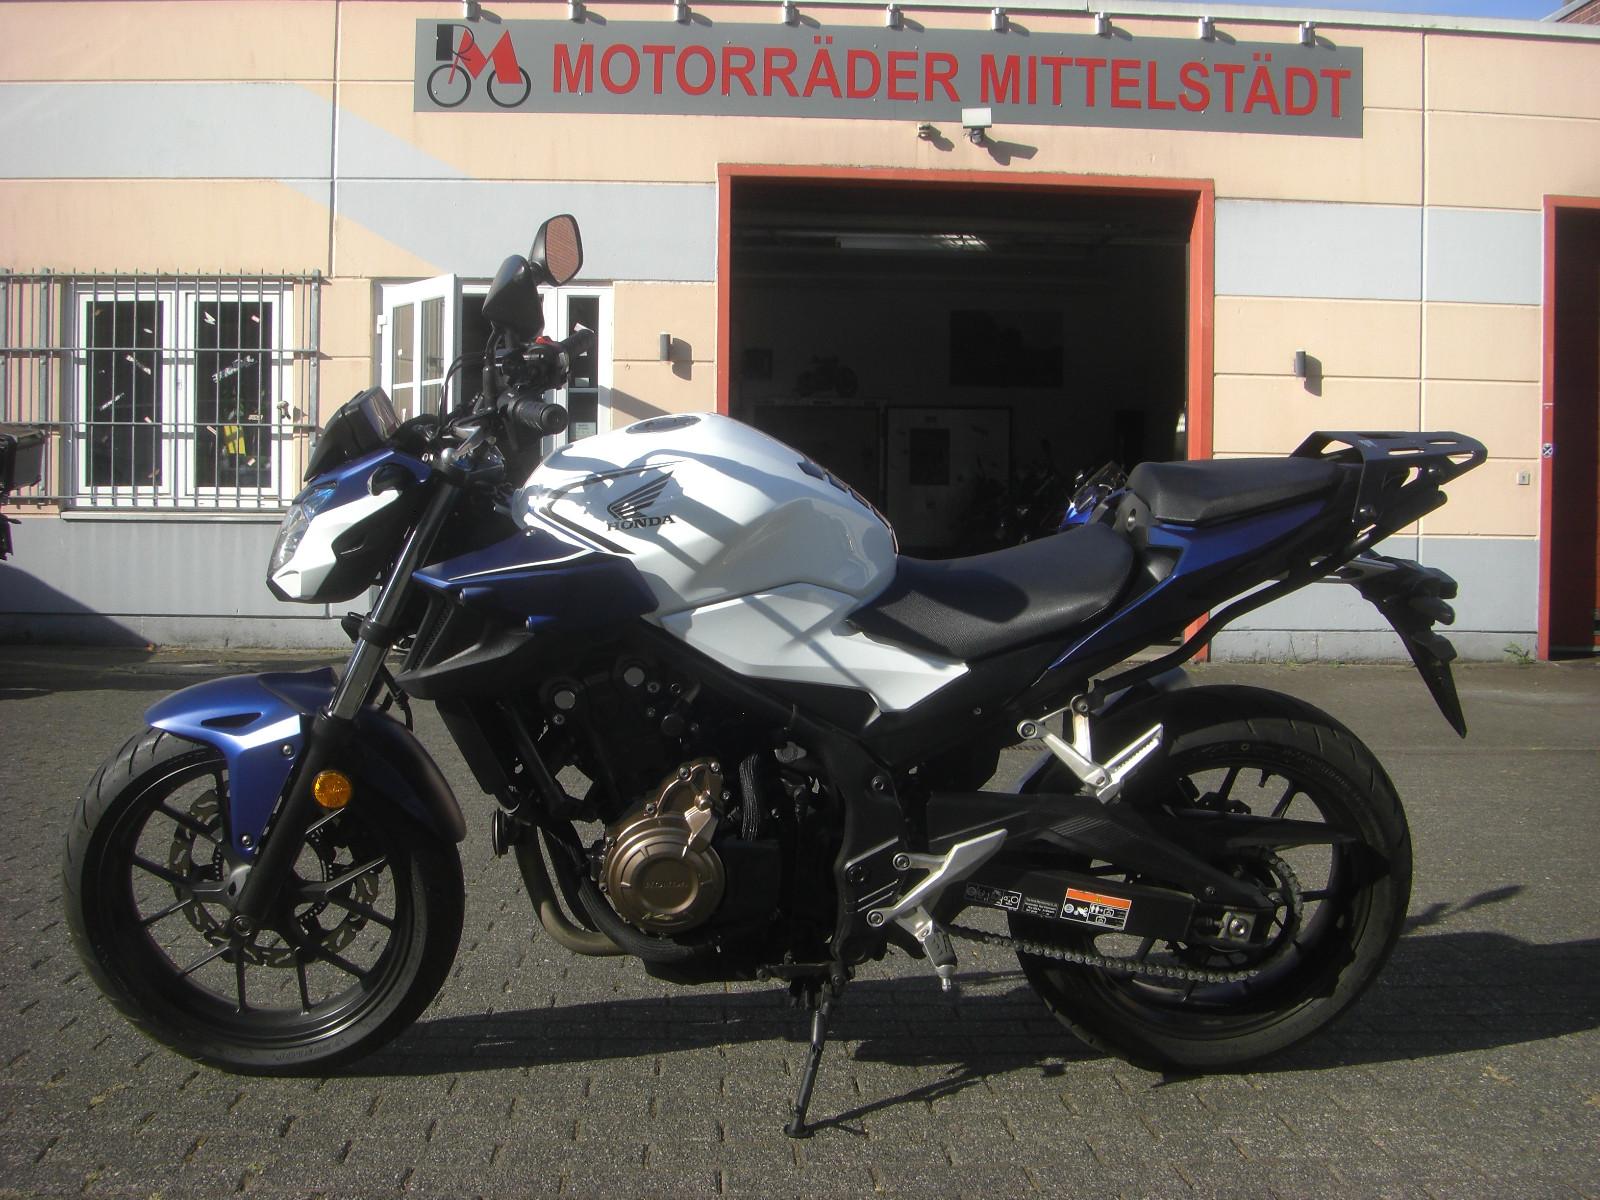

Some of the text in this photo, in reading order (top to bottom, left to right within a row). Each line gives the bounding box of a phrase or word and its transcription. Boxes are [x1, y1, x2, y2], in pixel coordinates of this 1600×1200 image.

[553, 36, 1352, 118] MOTORRÄDER MITTELSTÄDT
[608, 515, 675, 531] HONDA
